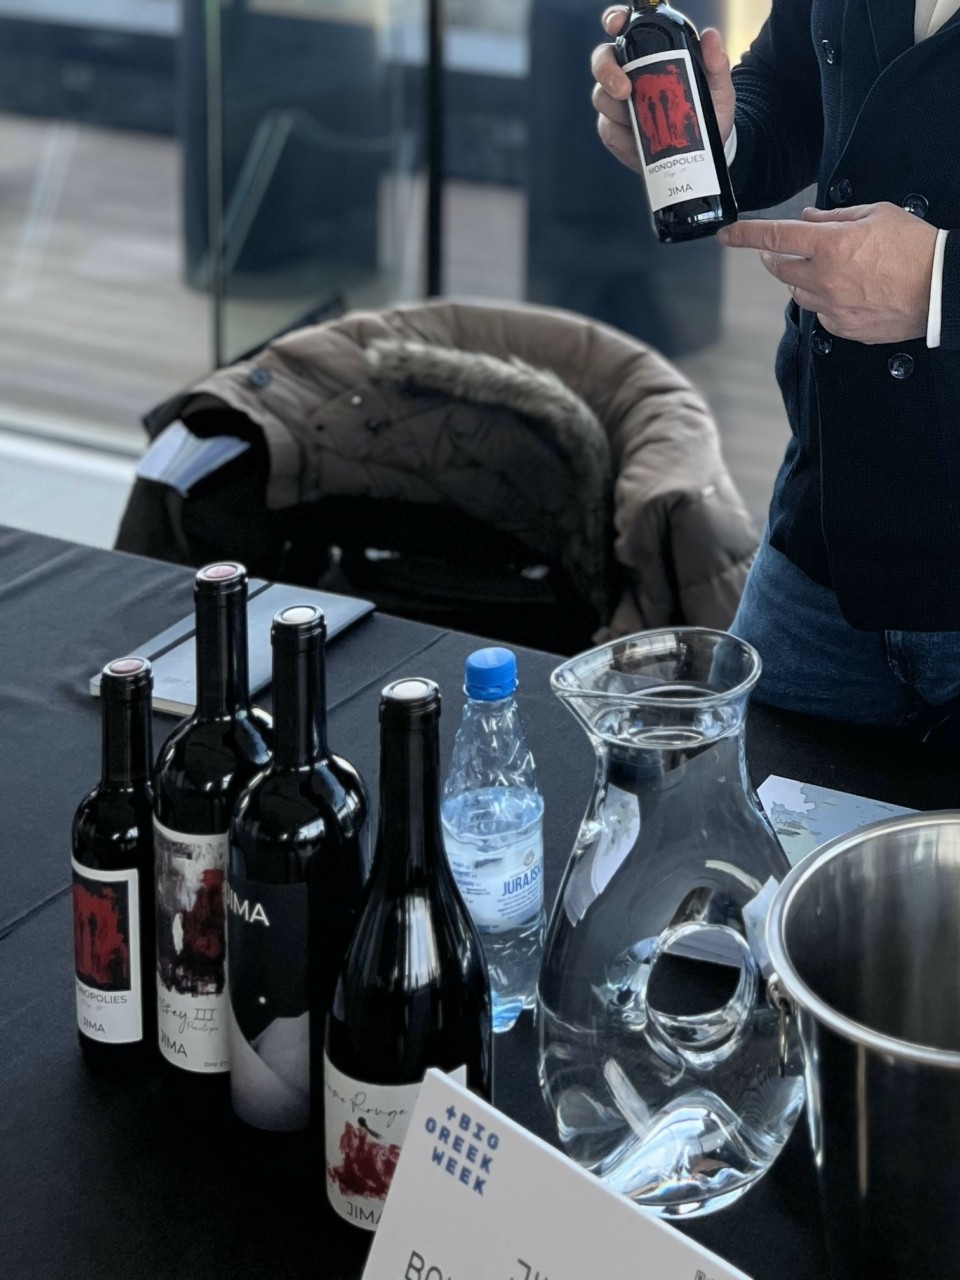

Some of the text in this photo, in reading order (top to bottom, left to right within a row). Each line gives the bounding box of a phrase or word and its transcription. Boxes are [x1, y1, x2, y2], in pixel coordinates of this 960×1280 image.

[648, 153, 705, 175] MONOPOLIES
[667, 183, 694, 197] JIMA
[83, 1015, 106, 1034] JIMA
[160, 1029, 188, 1058] JIMA
[350, 1091, 407, 1129] Rouge
[424, 1116, 494, 1175] GREEK
[430, 1145, 487, 1196] WEEK
